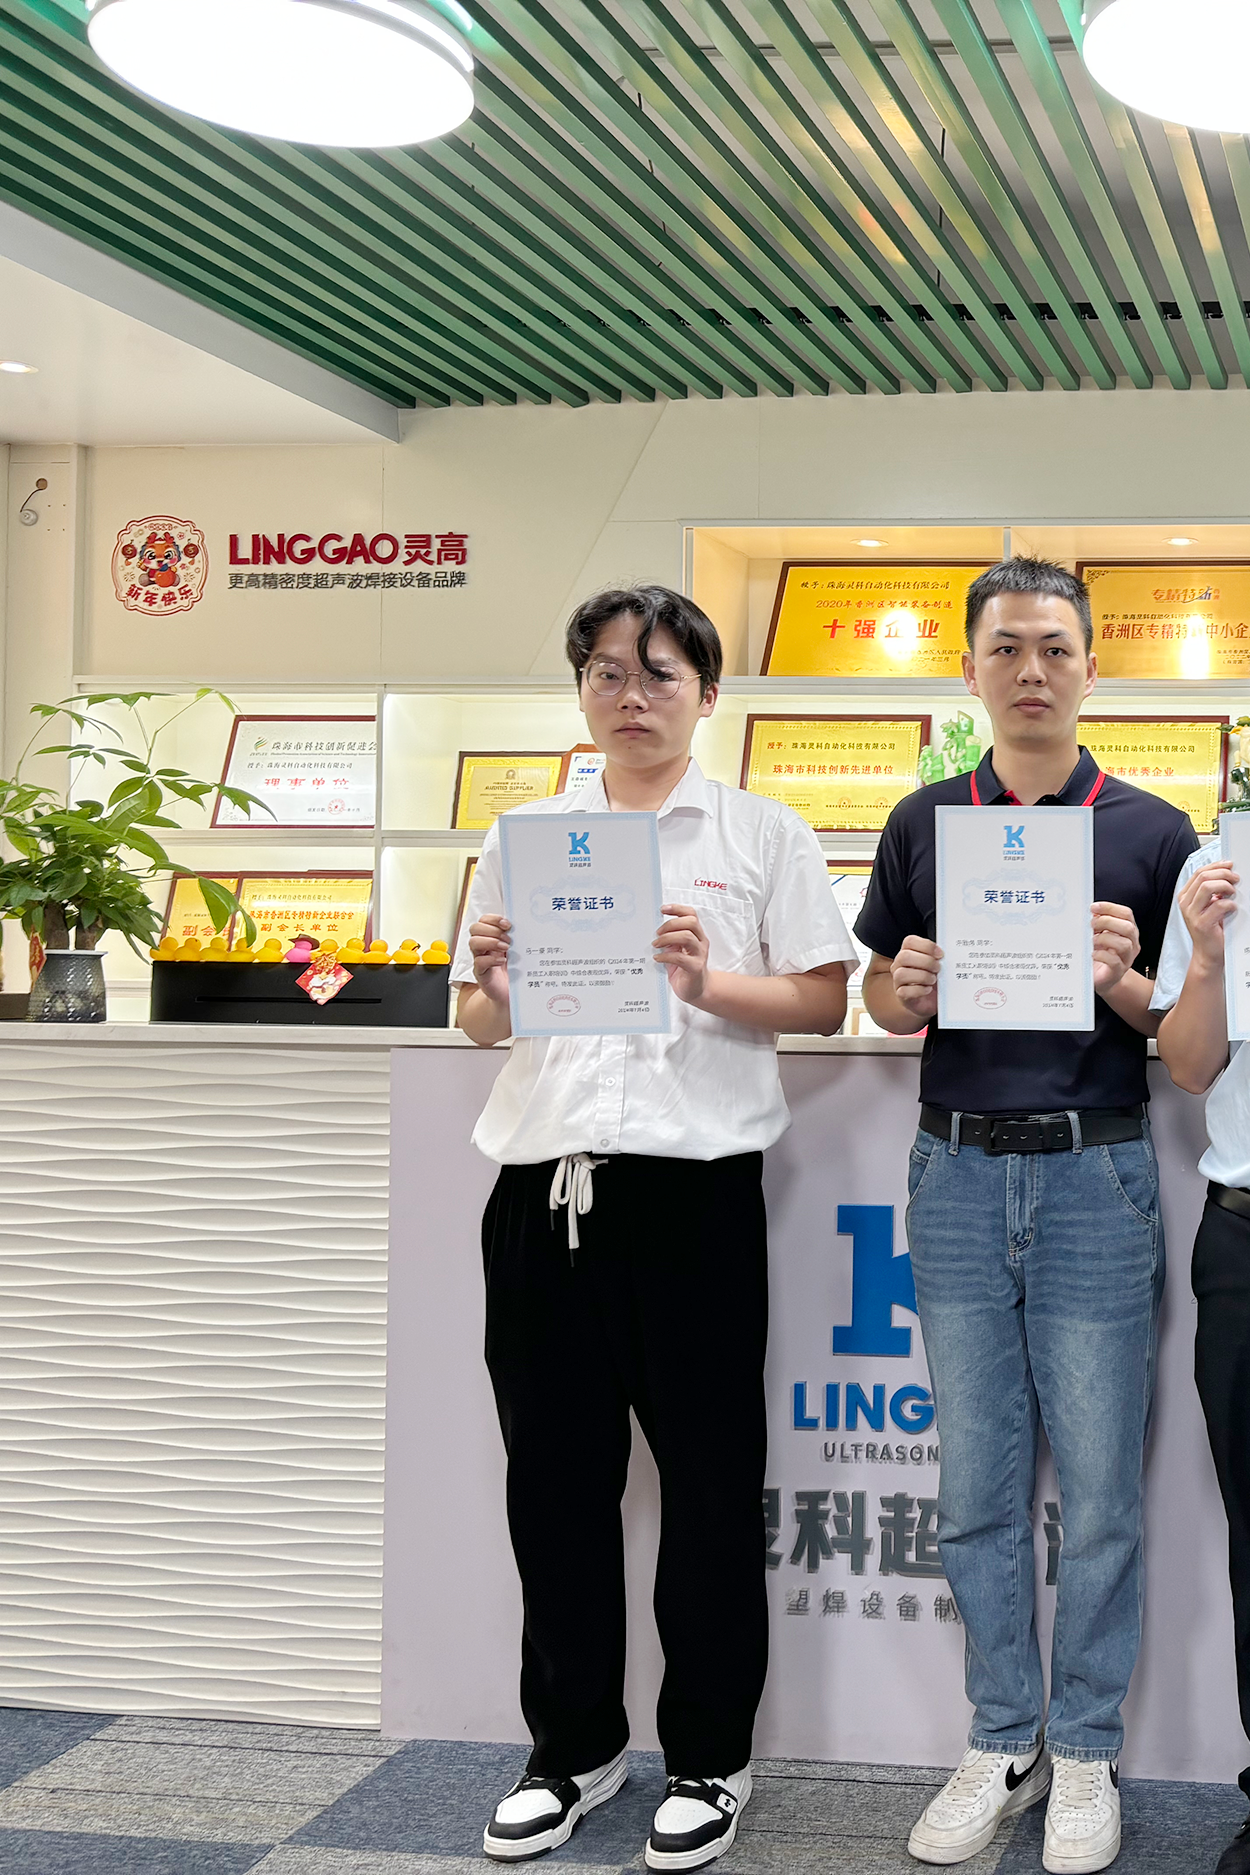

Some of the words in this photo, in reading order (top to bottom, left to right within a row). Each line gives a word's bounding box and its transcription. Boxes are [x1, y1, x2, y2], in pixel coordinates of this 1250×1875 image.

[228, 571, 467, 590] 更高精密度超声波焊接设备品牌
[125, 583, 194, 607] 新年快乐
[773, 764, 893, 775] 珠海市科技创新先进单位
[694, 878, 727, 891] LINGKE
[551, 895, 615, 911] 荣誉证书
[984, 890, 1046, 904] 荣誉证书
[261, 923, 339, 933] 副会长单位
[792, 1380, 938, 1434] LING
